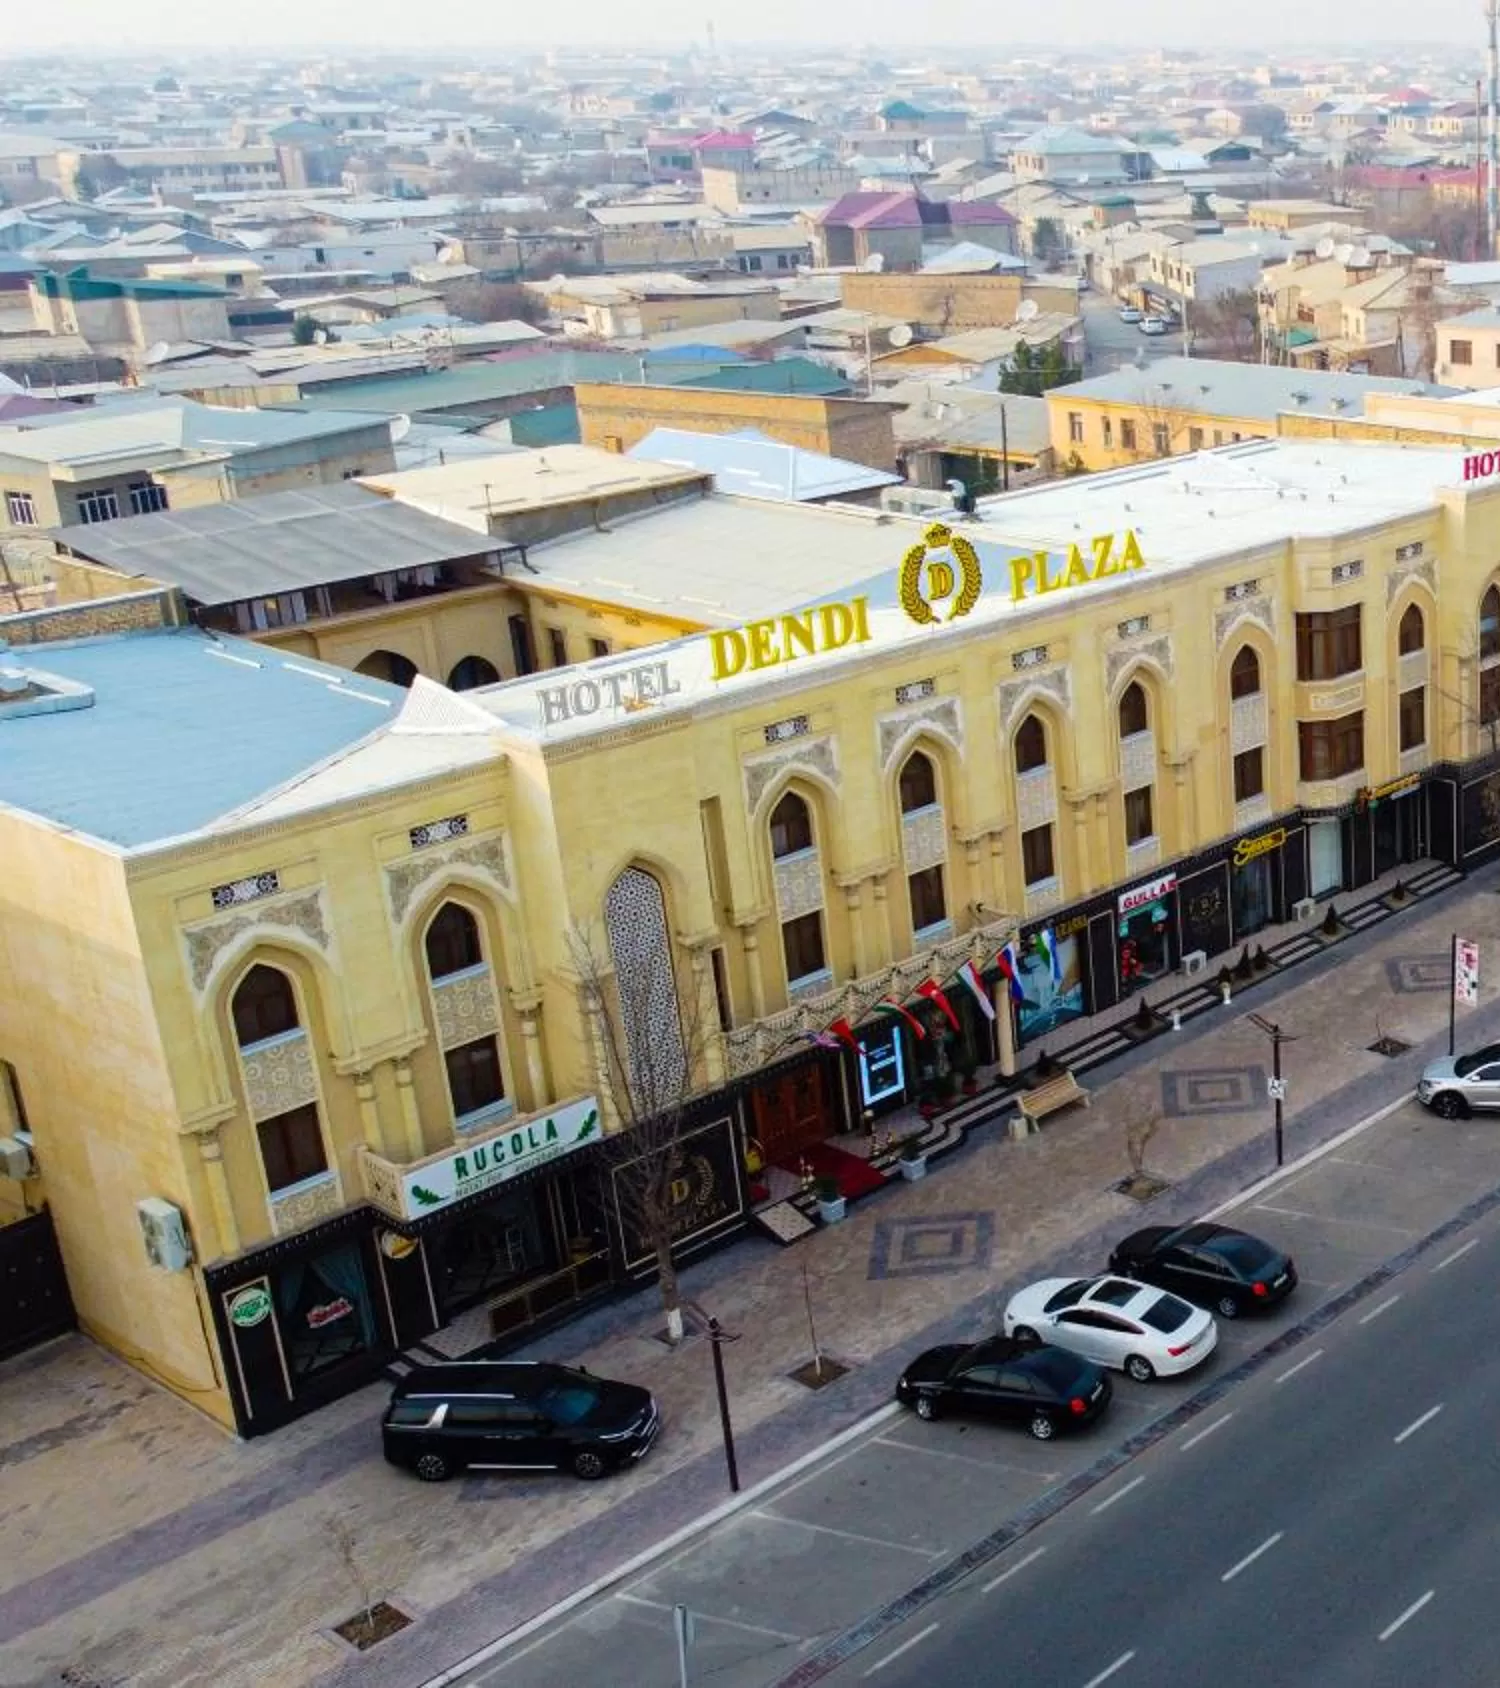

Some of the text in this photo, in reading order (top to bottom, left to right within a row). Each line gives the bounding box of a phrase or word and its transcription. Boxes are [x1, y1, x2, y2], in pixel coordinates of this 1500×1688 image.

[927, 561, 955, 601] D
[536, 528, 1146, 724] HOTEL DENDI PLAZA
[454, 1119, 558, 1179] RUCOLA
